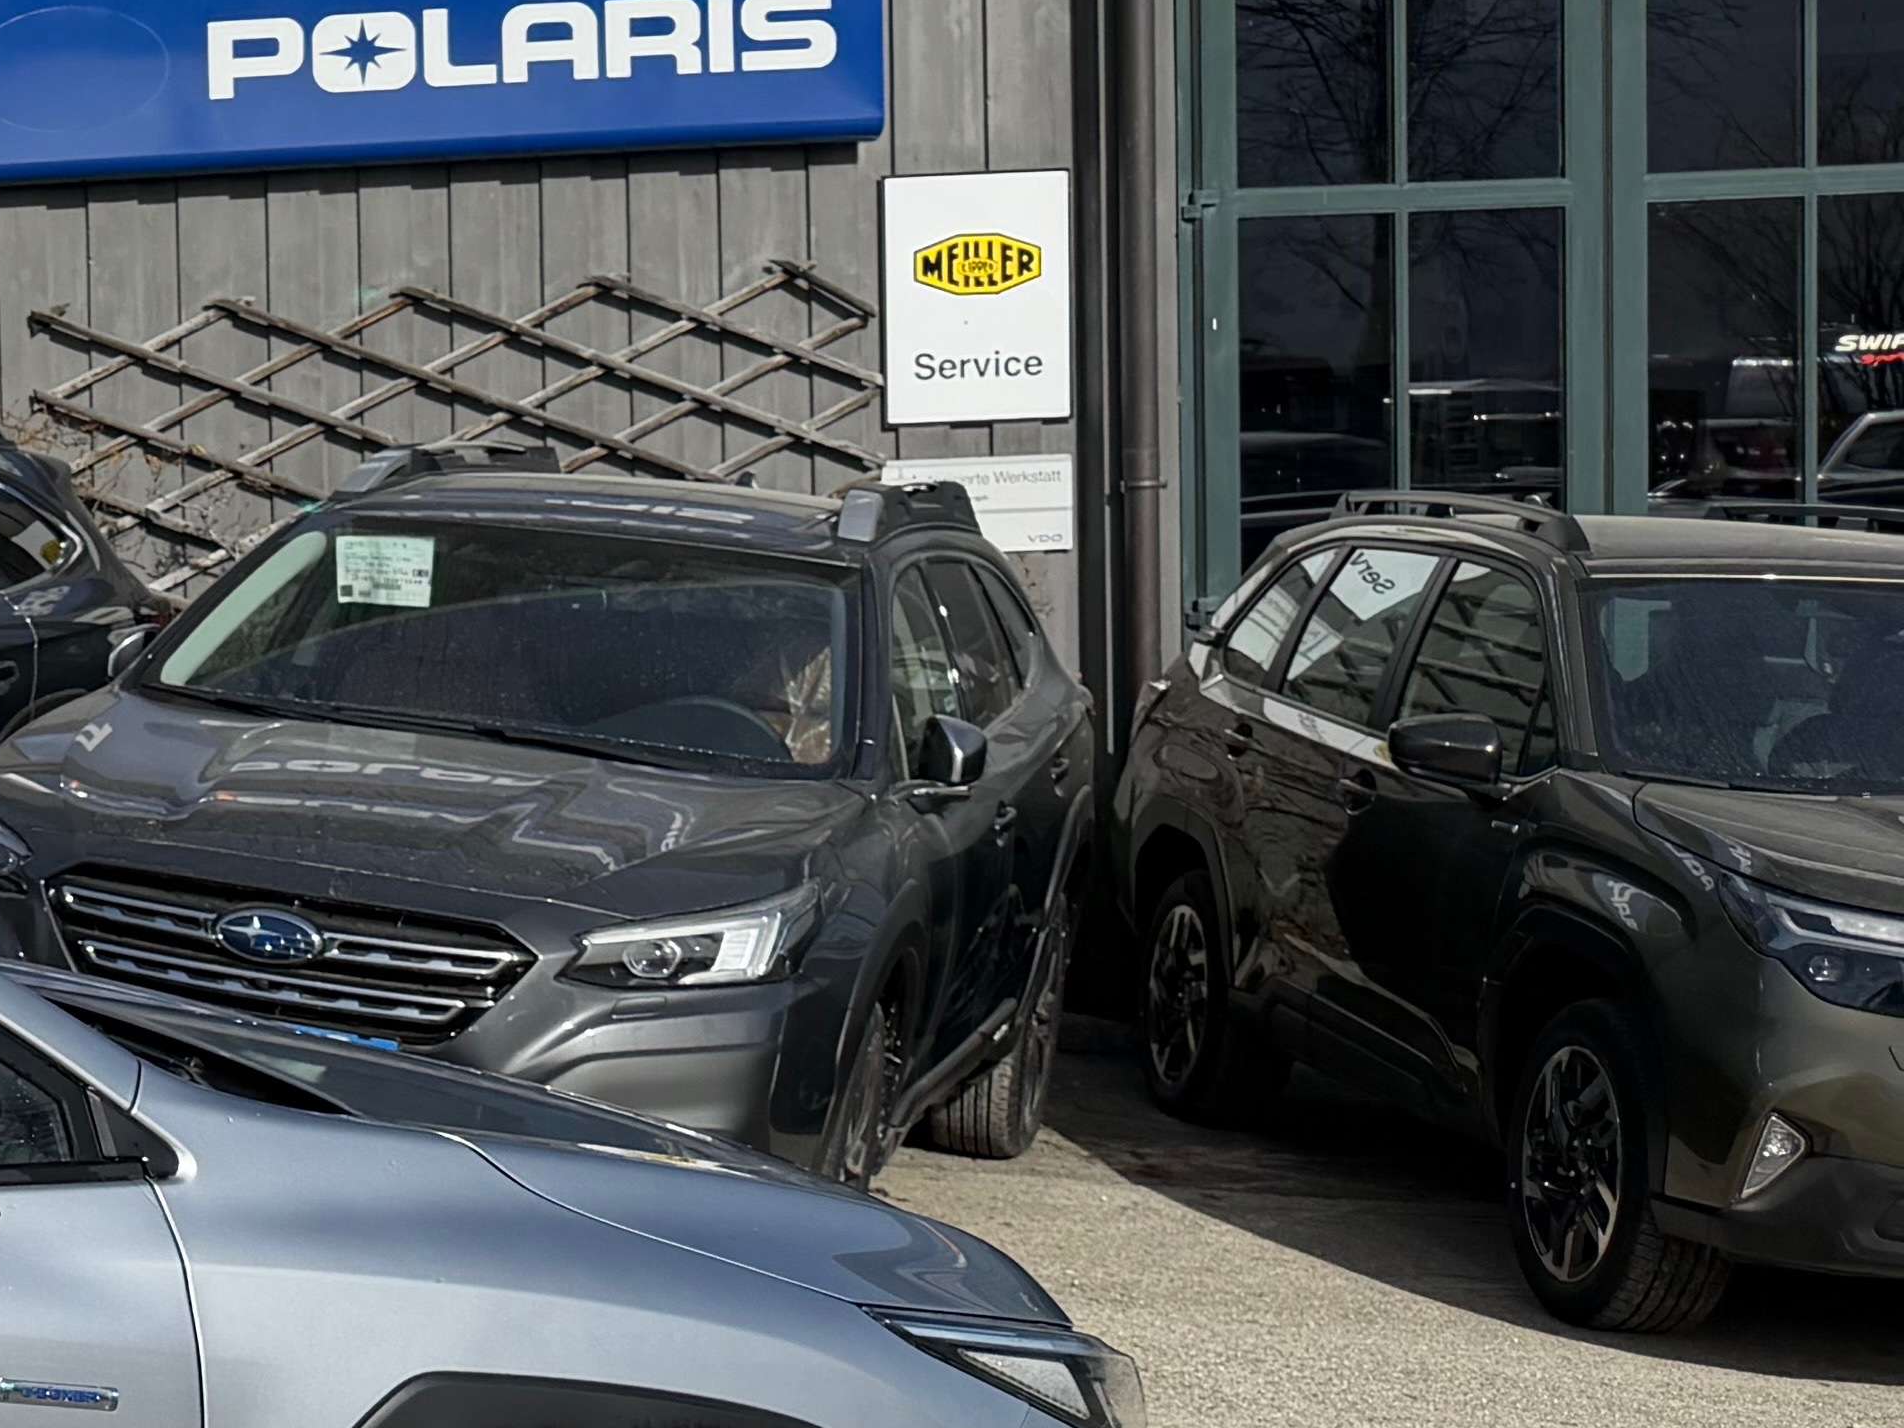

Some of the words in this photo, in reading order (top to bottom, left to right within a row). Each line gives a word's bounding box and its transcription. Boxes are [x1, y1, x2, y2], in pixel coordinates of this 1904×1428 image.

[922, 240, 1035, 288] MEILLER
[914, 350, 1043, 380] Service
[1027, 534, 1063, 543] VDO
